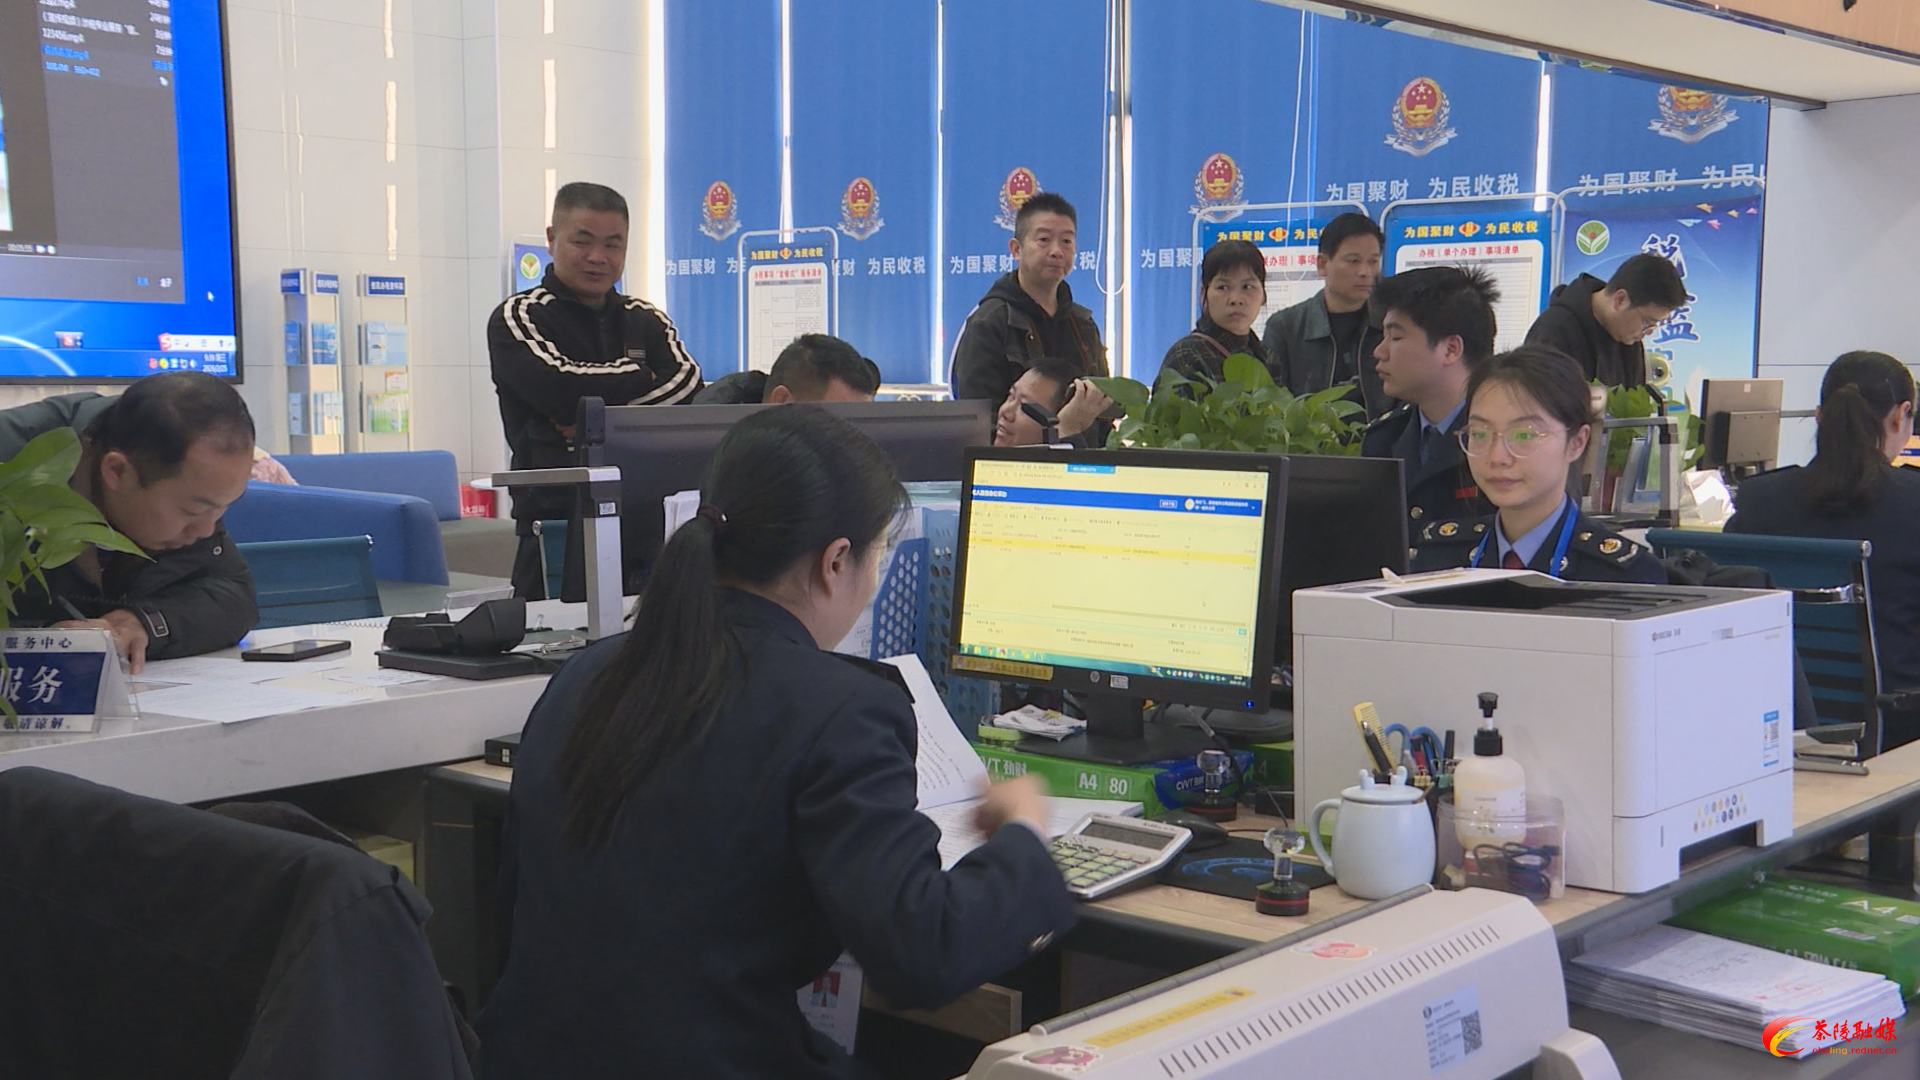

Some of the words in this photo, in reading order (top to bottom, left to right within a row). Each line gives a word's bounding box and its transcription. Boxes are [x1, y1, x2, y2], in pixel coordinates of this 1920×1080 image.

[1326, 178, 1409, 203] 为国聚财
[1428, 172, 1519, 199] 为民收税
[1578, 168, 1678, 197] 为国聚财
[1293, 227, 1325, 240] 为民
[1404, 225, 1454, 238] 为国聚财
[1485, 220, 1539, 234] 为民收税
[665, 257, 716, 276] 为国聚财
[867, 256, 926, 276] 为民收税
[950, 253, 1014, 275] 为国聚财
[5, 636, 72, 649] 服务中心
[0, 665, 63, 703] 服务
[1079, 772, 1097, 790] A4
[1109, 777, 1127, 795] 80
[1841, 900, 1898, 914] A4
